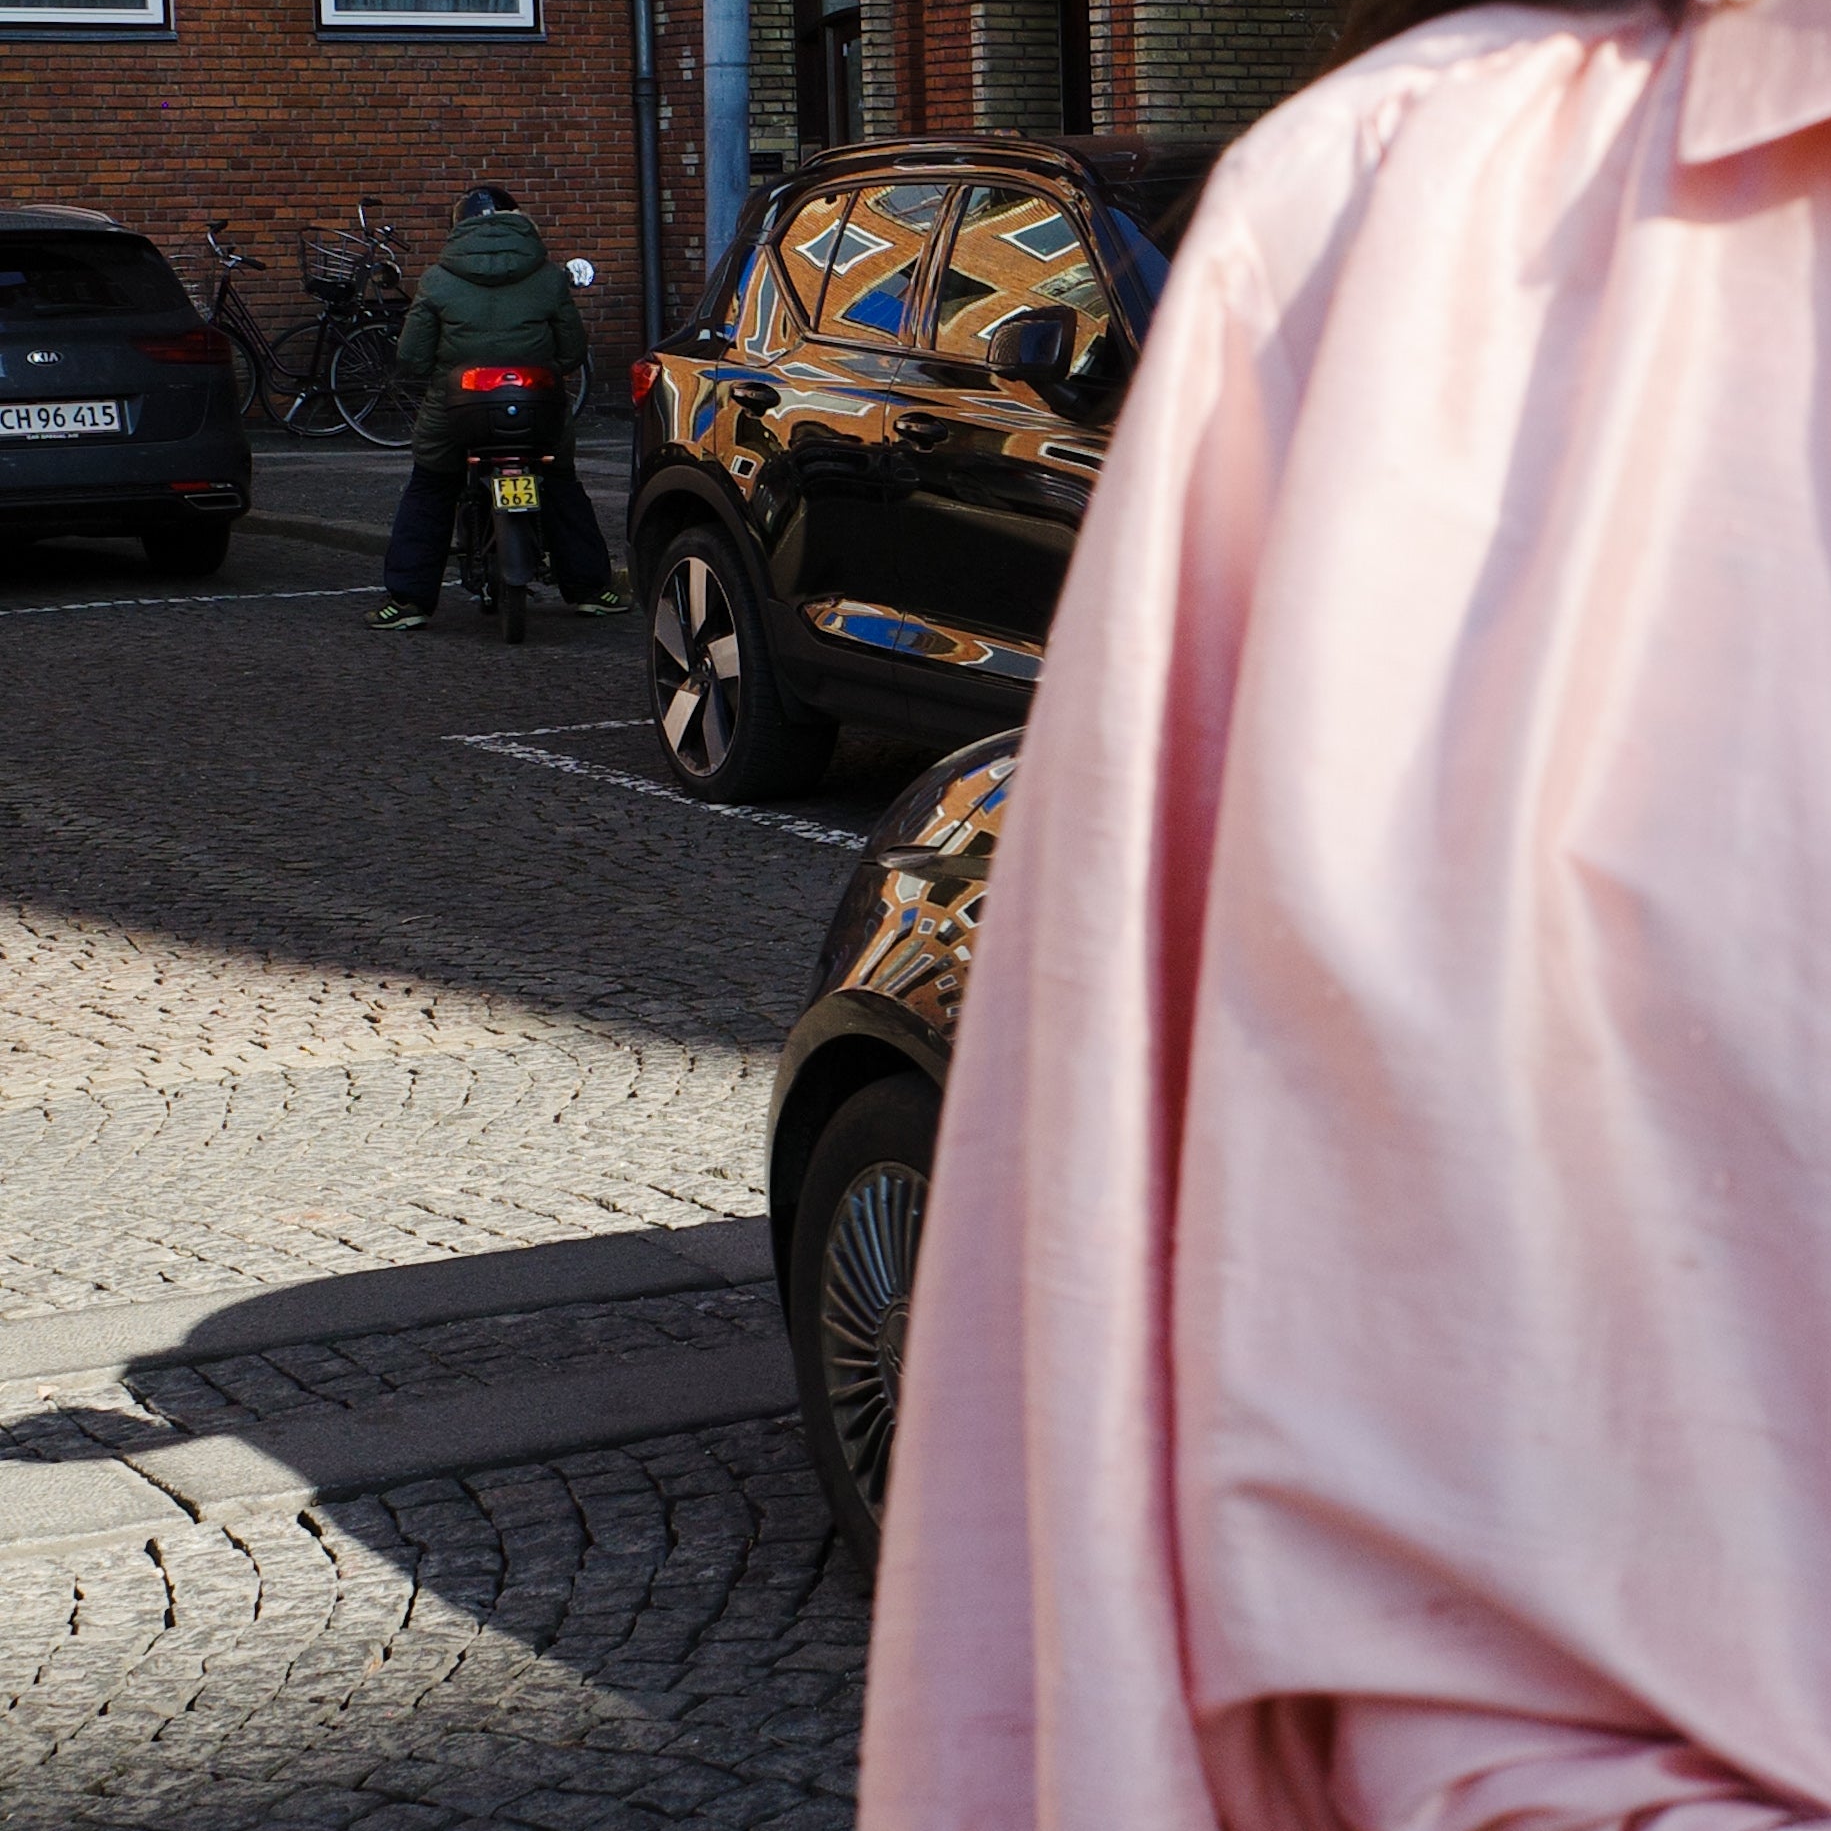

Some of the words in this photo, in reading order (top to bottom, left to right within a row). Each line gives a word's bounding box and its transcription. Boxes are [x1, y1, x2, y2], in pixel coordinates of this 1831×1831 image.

[33, 352, 59, 362] KIA
[0, 409, 31, 429] CH
[37, 407, 66, 428] 96
[73, 405, 115, 427] 415
[498, 478, 532, 491] FT2
[500, 492, 534, 506] 662
